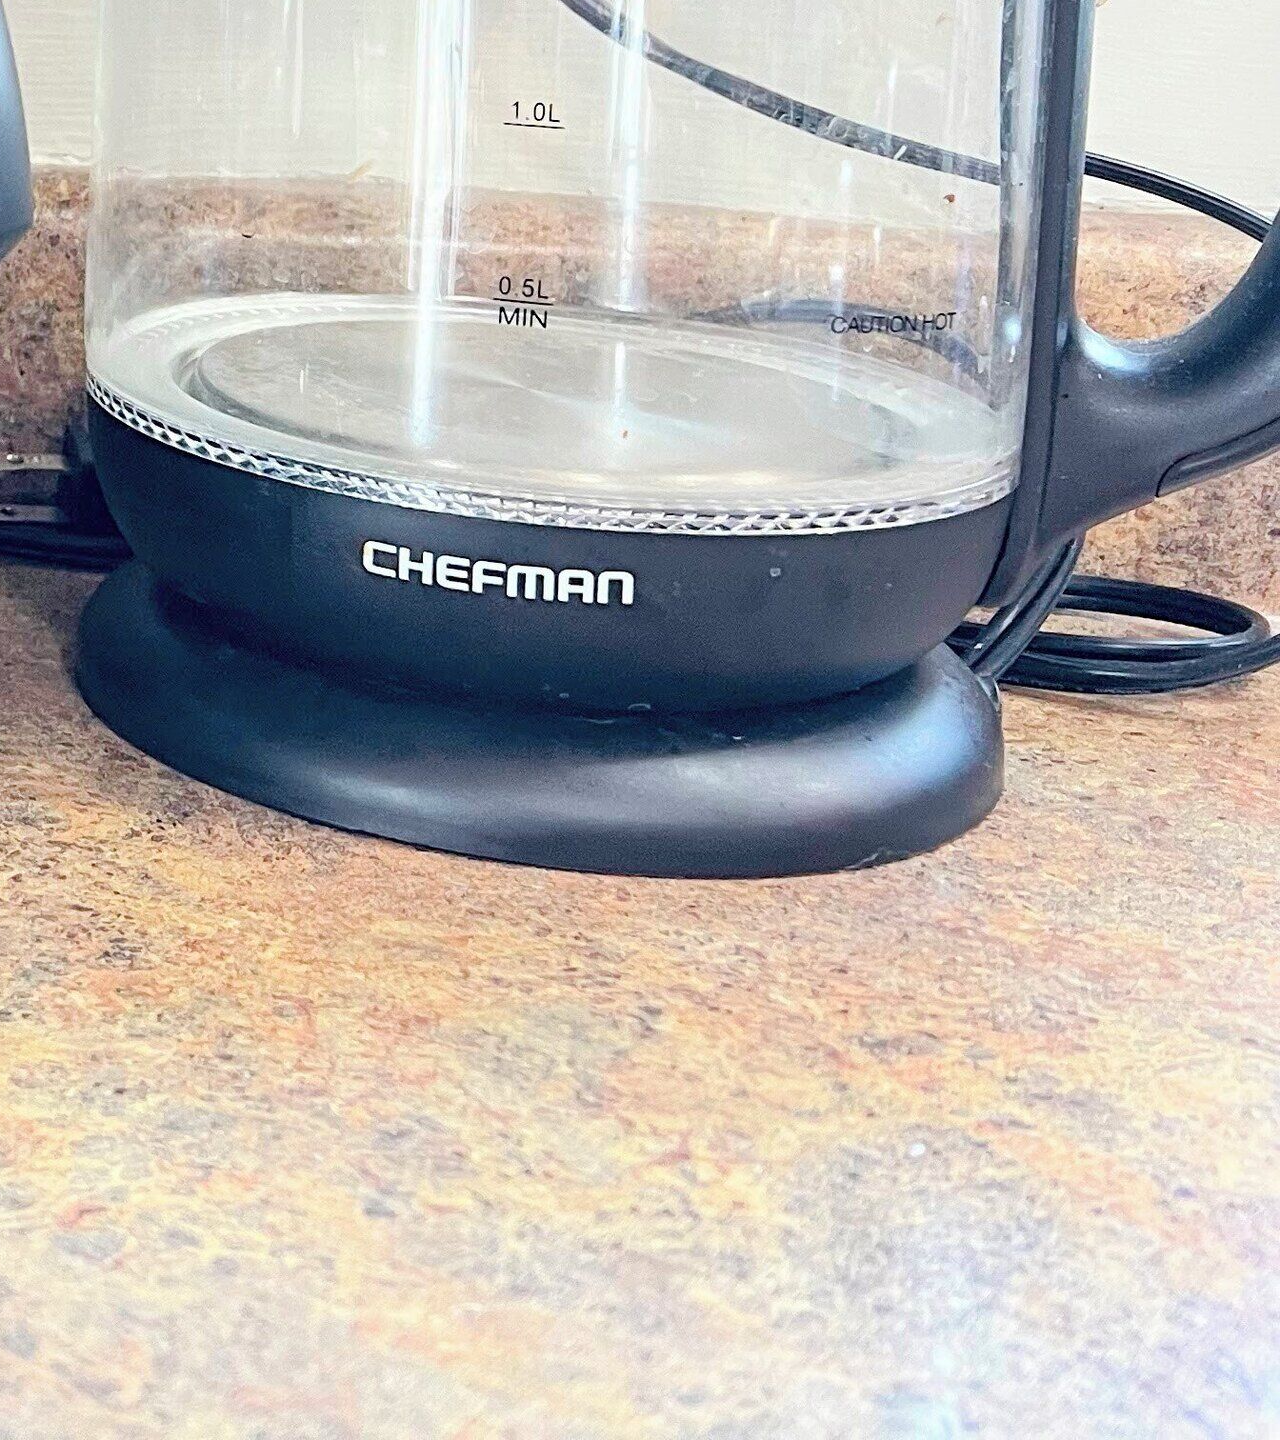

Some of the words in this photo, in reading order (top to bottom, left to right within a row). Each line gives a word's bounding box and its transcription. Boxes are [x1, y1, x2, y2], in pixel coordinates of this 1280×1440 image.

[512, 101, 561, 123] 1.0L
[498, 275, 549, 299] 0.5L
[498, 306, 548, 329] MIN
[830, 314, 917, 334] CAUTION
[922, 311, 957, 332] HOT
[362, 539, 635, 606] CHEFMAN
